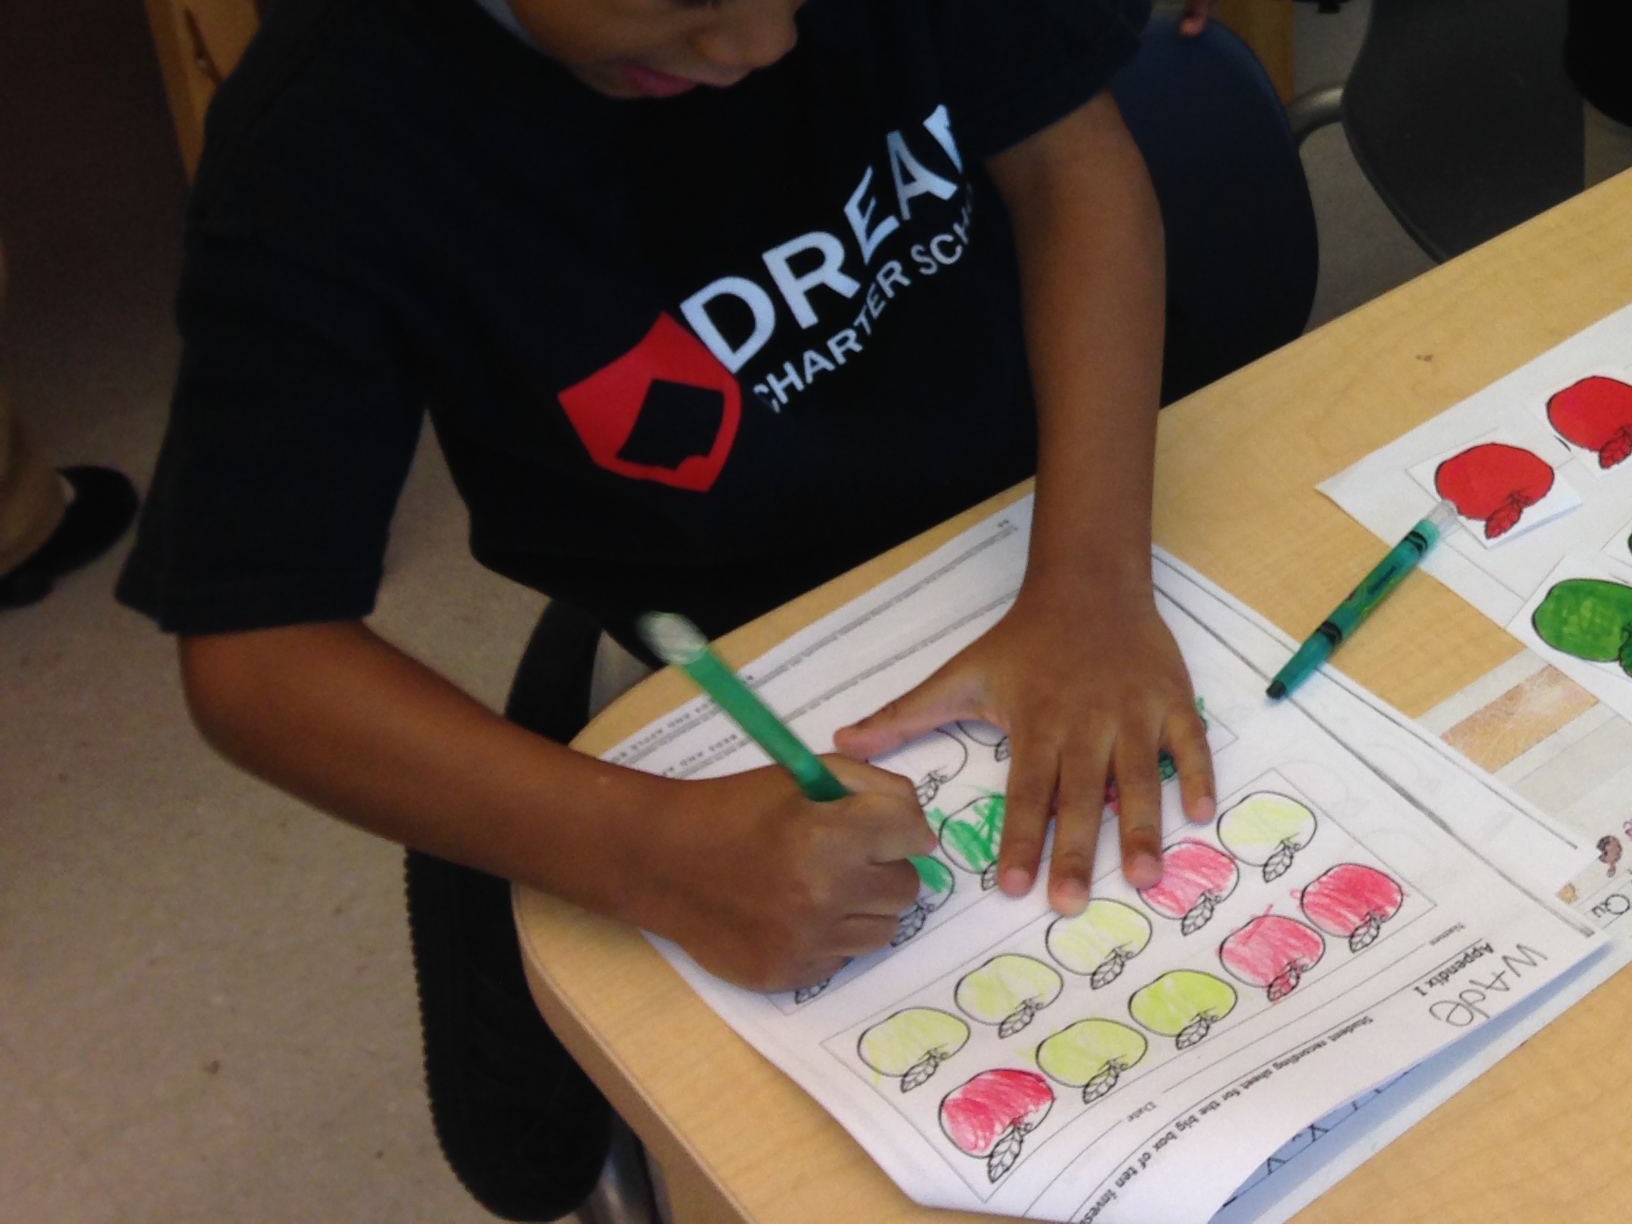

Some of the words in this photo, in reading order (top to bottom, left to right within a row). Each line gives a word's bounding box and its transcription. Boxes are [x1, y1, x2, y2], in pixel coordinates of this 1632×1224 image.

[752, 259, 912, 413] CHARTER
[1427, 941, 1495, 990] Appendix
[1329, 1015, 1374, 1043] Student
[1272, 1040, 1327, 1072] recording
[1241, 1065, 1274, 1090] sheet
[1222, 1088, 1242, 1102] for
[1199, 1099, 1221, 1116] the
[1176, 1114, 1200, 1133] big
[1152, 1130, 1179, 1152] box
[1137, 1151, 1153, 1170] of
[1114, 1168, 1139, 1189] ten
